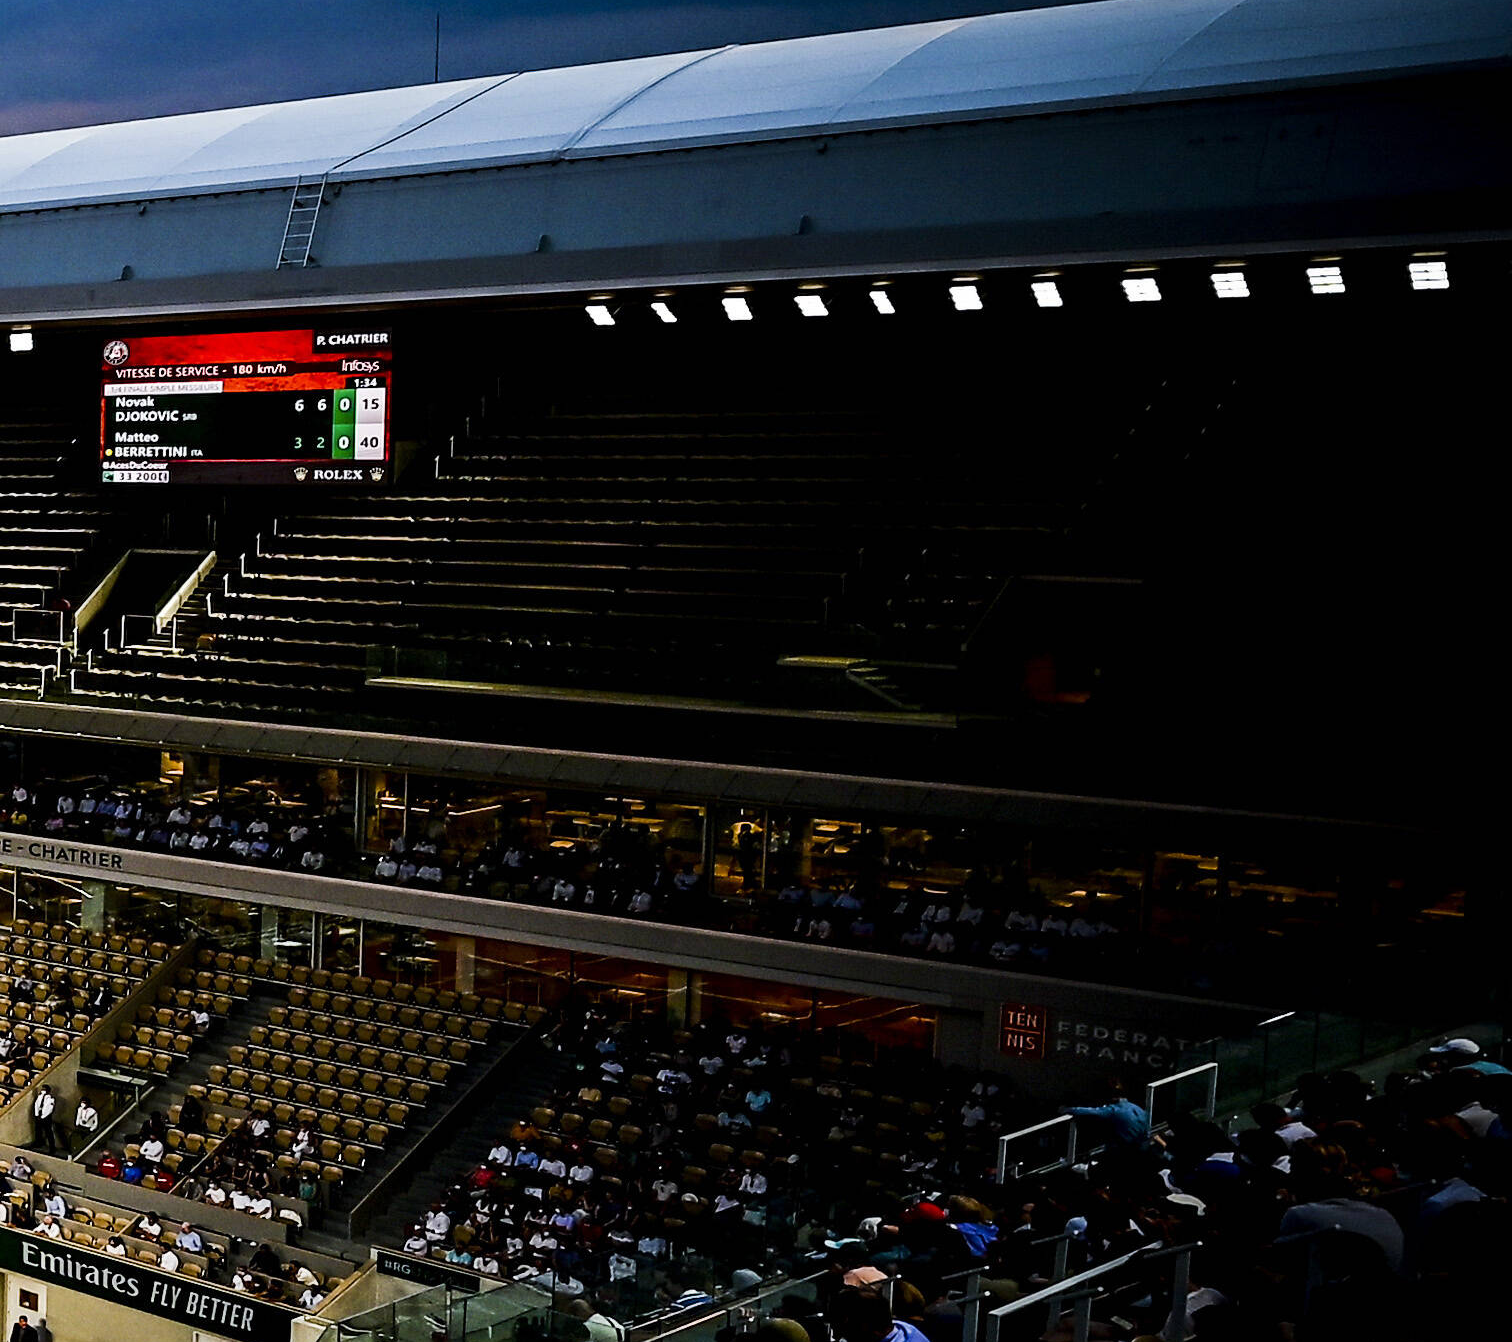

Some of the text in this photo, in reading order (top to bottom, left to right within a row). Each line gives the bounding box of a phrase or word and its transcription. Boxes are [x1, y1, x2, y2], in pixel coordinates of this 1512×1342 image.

[328, 333, 388, 345] CHATRIER
[116, 367, 155, 378] VITESSE
[158, 367, 172, 377] DE
[176, 366, 219, 377] SERVICE
[232, 364, 253, 375] 180
[257, 363, 287, 374] km/h
[342, 360, 379, 373] Infosys
[354, 378, 377, 387] 1:34
[115, 395, 155, 407] Novak
[295, 398, 379, 411] 6 6 0 15
[115, 410, 179, 422] DJOKOVIC
[115, 432, 159, 442] Matteo
[294, 436, 379, 449] 3 2 0 40
[115, 446, 187, 457] BERRETTINI
[314, 470, 363, 480] ROLEX
[28, 843, 122, 868] CHATRIER
[1007, 1010, 1038, 1029] TEN
[1005, 1035, 1036, 1051] NIS
[1057, 1021, 1196, 1052] FEDERAT
[1056, 1040, 1165, 1068] FRANC
[384, 1260, 412, 1275] #RG
[21, 1240, 255, 1332] Emirates FLY BETTER
